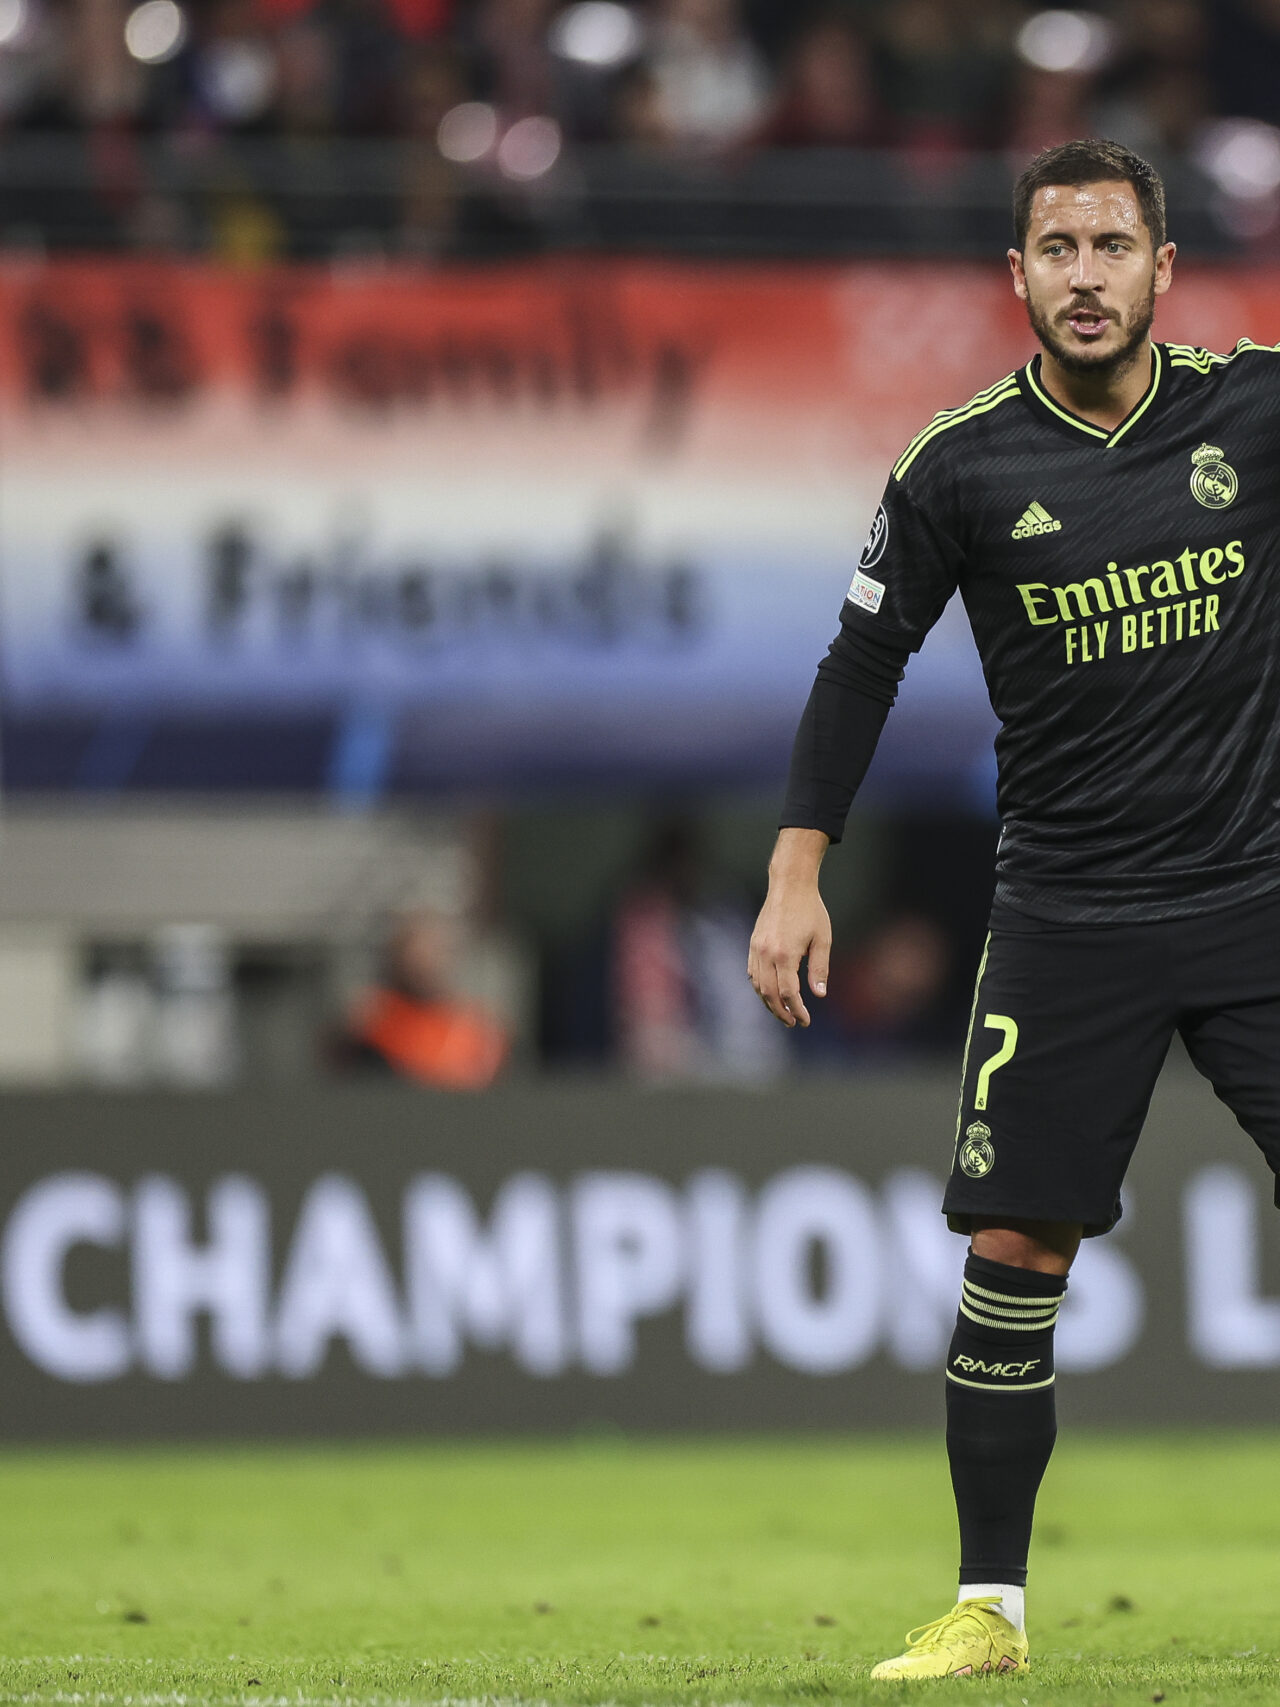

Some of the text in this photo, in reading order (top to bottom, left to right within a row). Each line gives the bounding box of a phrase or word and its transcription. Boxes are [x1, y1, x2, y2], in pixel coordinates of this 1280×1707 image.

[1011, 520, 1062, 540] adidas
[202, 492, 706, 648] Friends
[1015, 540, 1245, 626] Emirates
[1065, 594, 1220, 665] FLY BETTER
[974, 1013, 1019, 1111] 7
[953, 1354, 1041, 1377] RMCF
